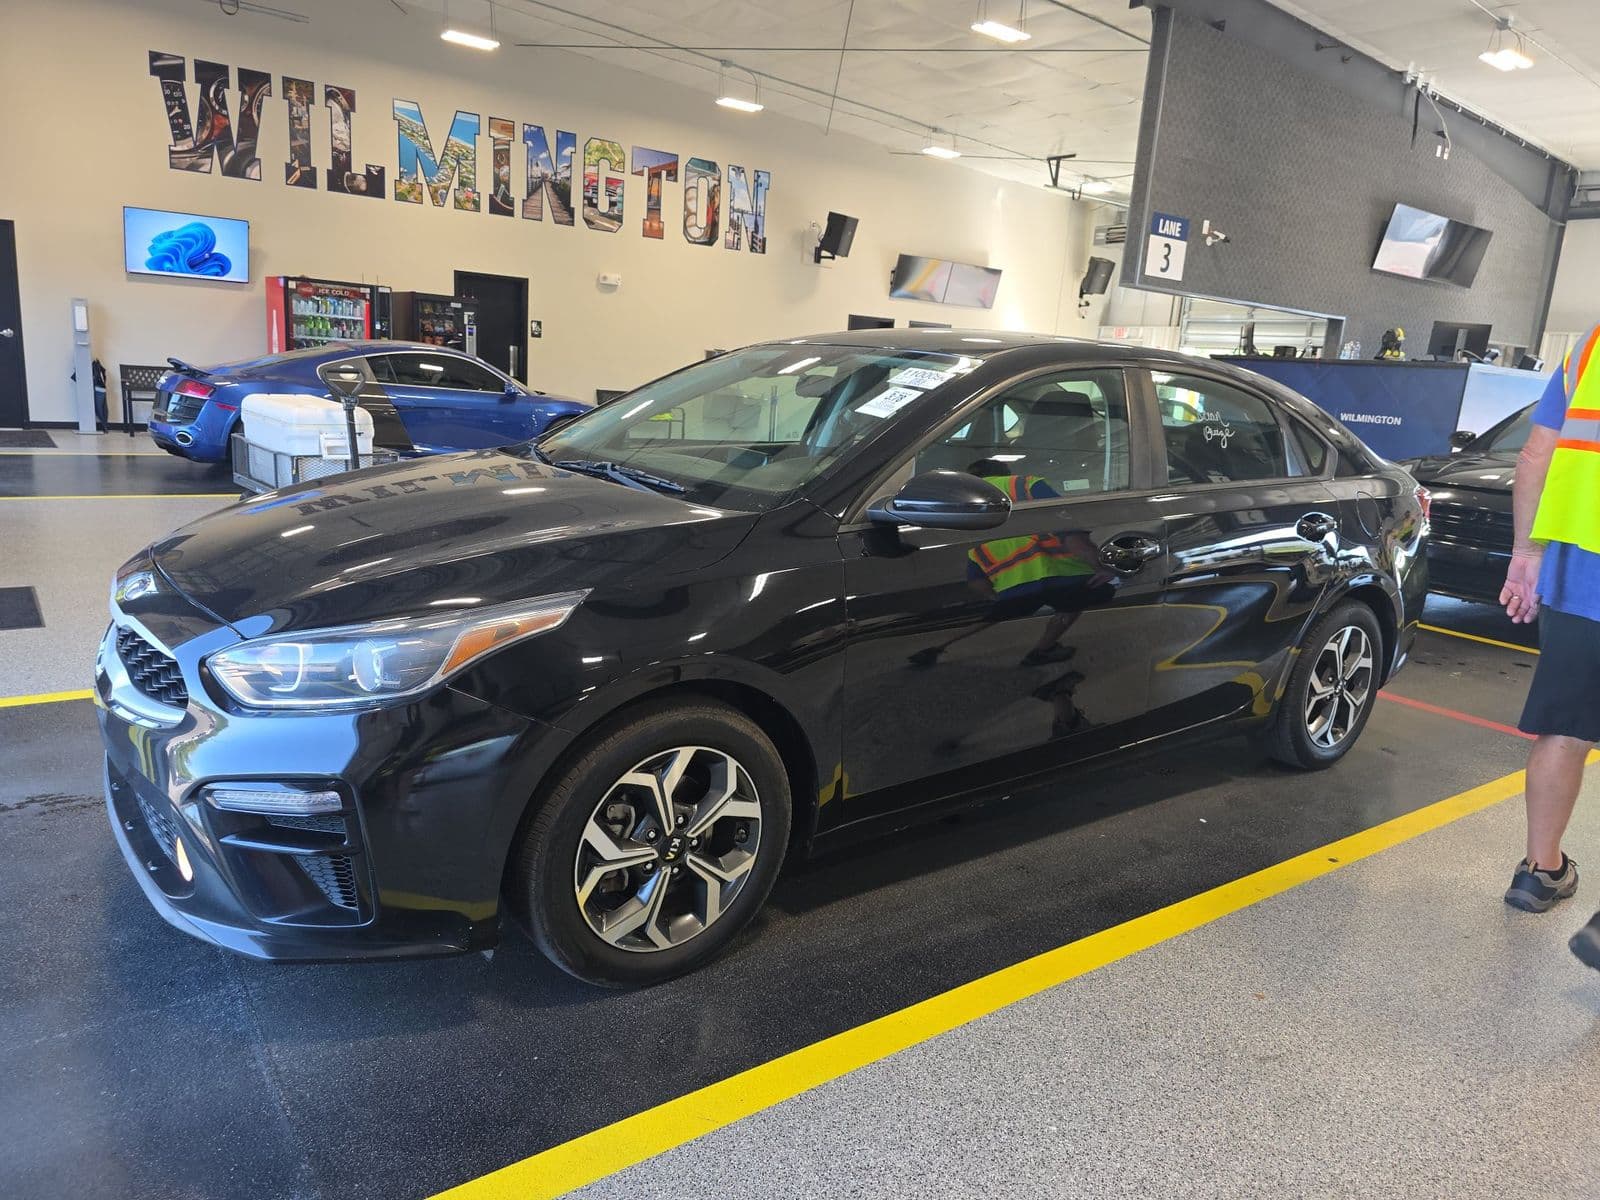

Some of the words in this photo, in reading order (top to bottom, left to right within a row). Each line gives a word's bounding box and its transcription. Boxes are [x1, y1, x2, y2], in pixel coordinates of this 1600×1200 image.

[149, 51, 770, 254] WILMINGTON
[1159, 219, 1182, 236] LANE
[1160, 242, 1172, 273] 3
[1340, 412, 1402, 426] WILMINGTON
[665, 838, 680, 859] KIA
